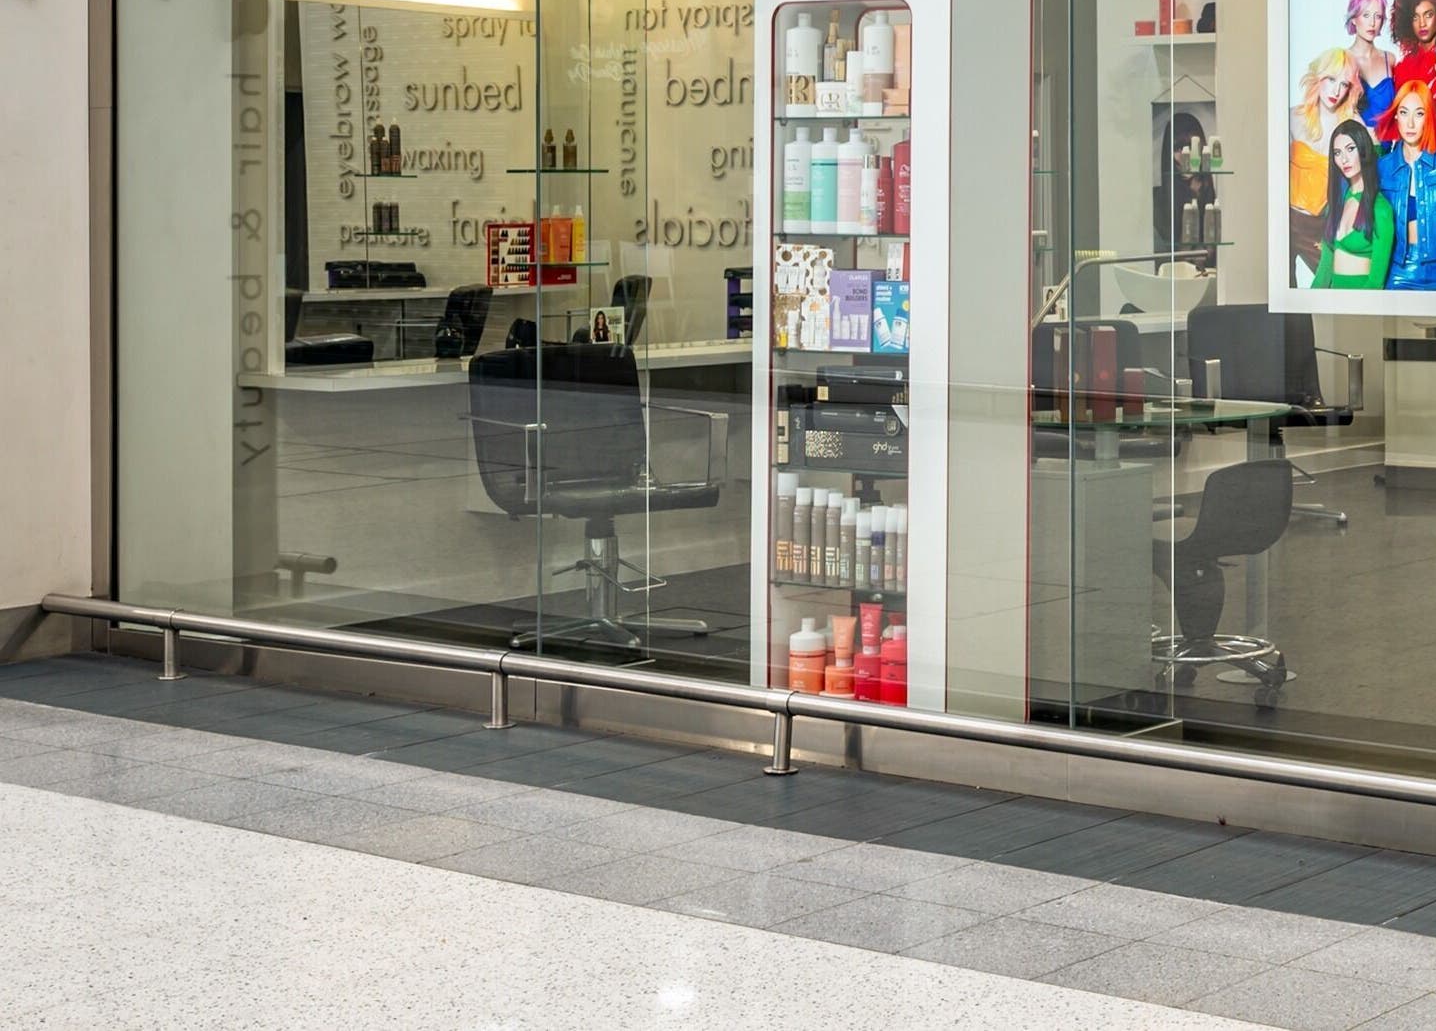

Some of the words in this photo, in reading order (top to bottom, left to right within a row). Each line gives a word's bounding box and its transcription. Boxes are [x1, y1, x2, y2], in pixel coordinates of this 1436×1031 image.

[361, 24, 385, 138] assage
[404, 65, 524, 112] sunbed
[328, 53, 361, 201] eyebrow
[401, 141, 485, 181] waxing
